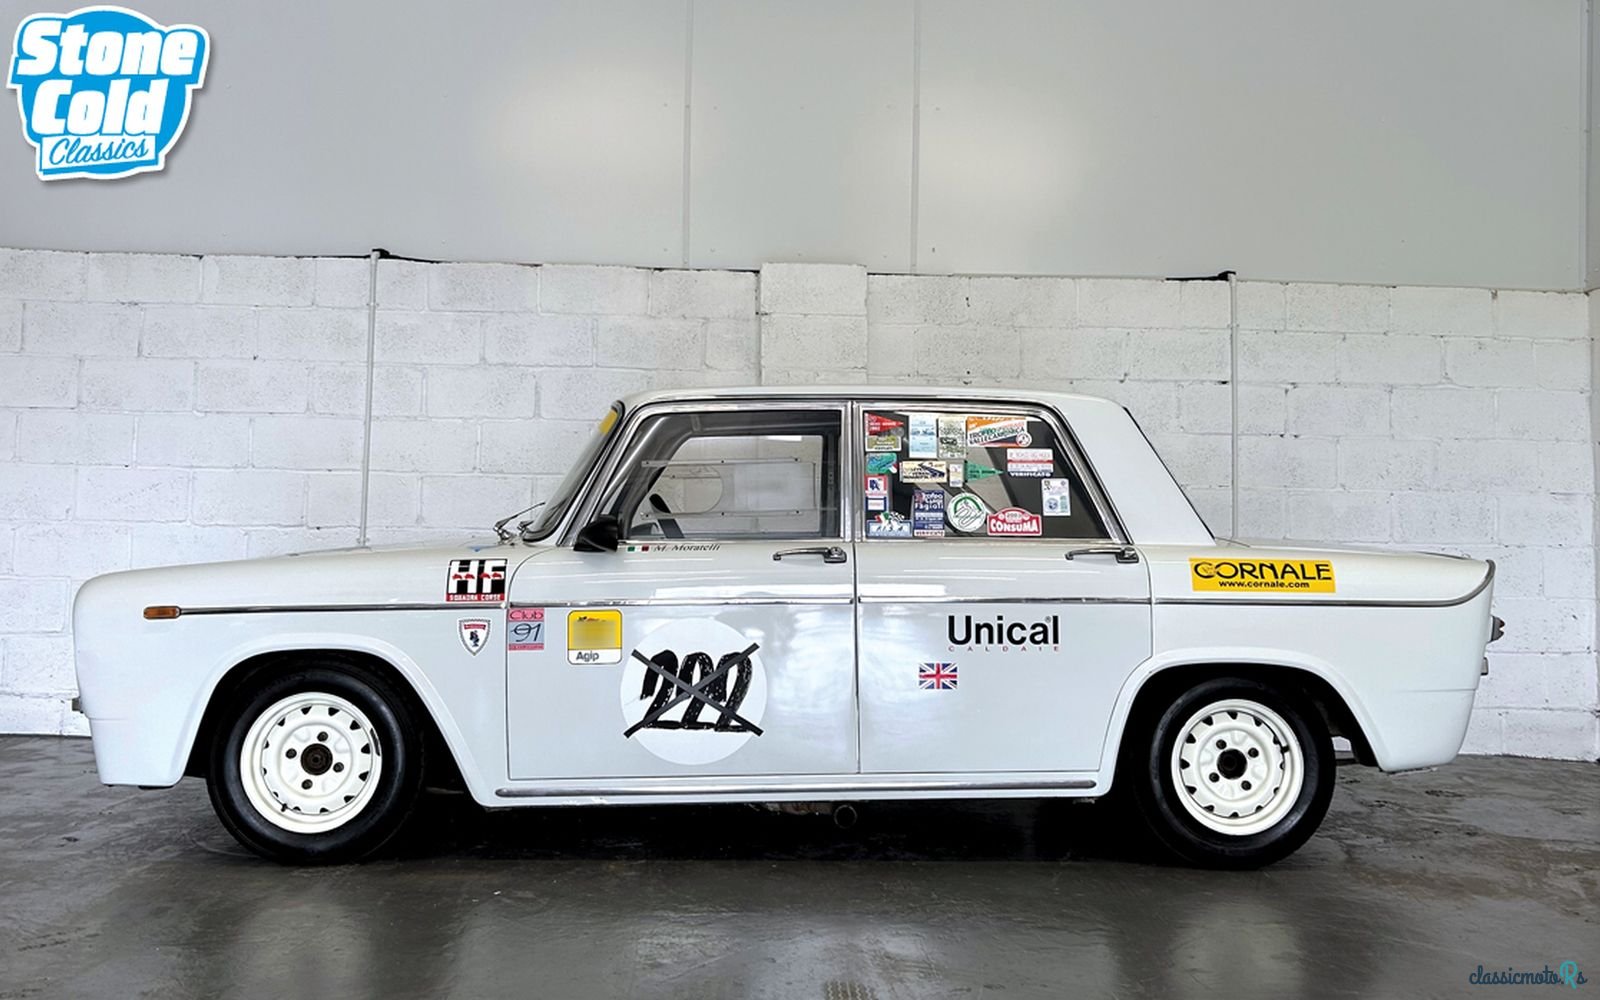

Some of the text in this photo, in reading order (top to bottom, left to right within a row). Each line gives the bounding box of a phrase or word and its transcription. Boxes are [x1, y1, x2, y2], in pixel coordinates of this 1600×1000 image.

[990, 518, 1039, 532] CONSUMA
[672, 543, 721, 551] Moratelli
[1194, 562, 1332, 580] CORNALE
[448, 561, 505, 594] HF
[1219, 580, 1310, 588] www.cornale.com
[481, 593, 501, 601] CORSE
[509, 610, 544, 620] Club
[511, 623, 541, 642] 91
[576, 651, 600, 662] Agip
